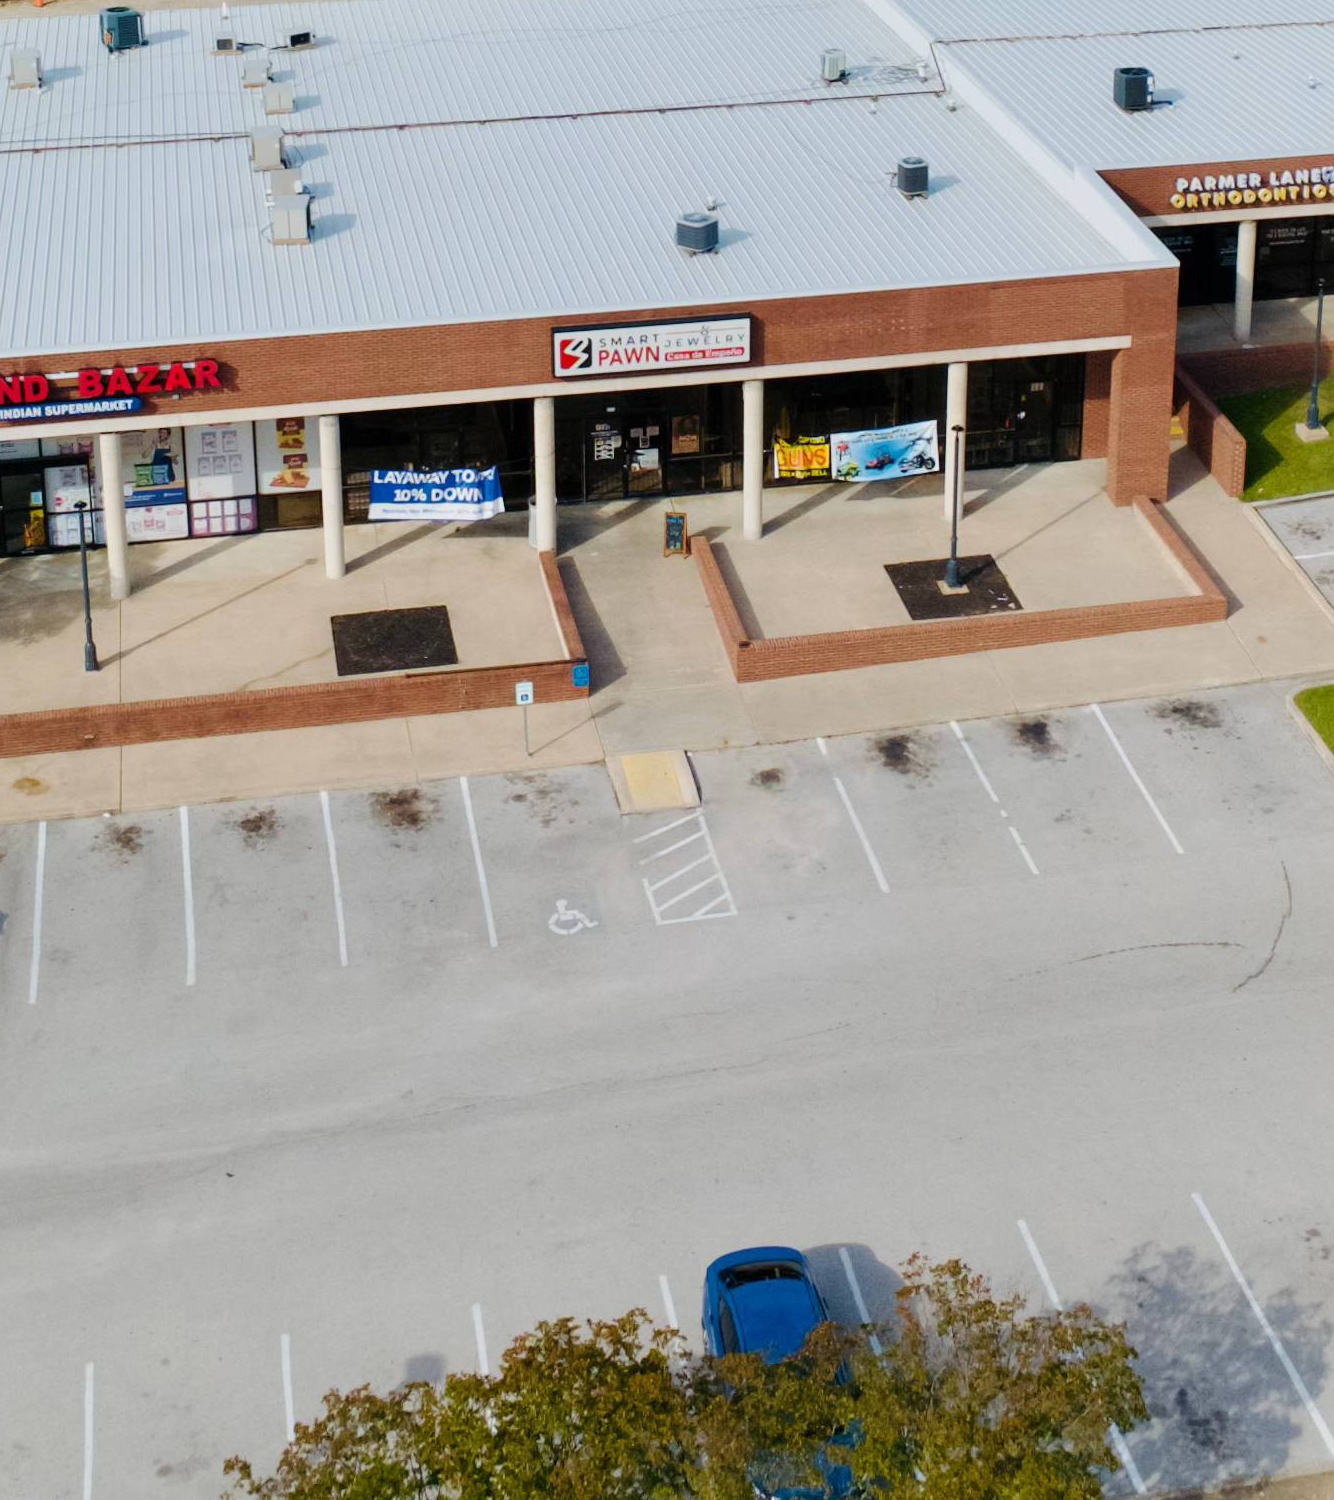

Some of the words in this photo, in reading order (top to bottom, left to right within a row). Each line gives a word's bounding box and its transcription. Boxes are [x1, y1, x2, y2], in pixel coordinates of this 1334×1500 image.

[1176, 172, 1262, 193] PARMER
[1269, 167, 1321, 187] LANE
[599, 334, 660, 348] SMART
[664, 334, 745, 349] JEWELRY
[599, 346, 660, 367] PAWN
[667, 351, 690, 361] Casa
[692, 350, 703, 360] de
[80, 359, 222, 397] BAZAR
[0, 405, 42, 420] INDIAN
[44, 399, 134, 417] SUPERMARKET
[373, 470, 449, 484] LAYAWAY
[394, 488, 427, 502] 10%
[431, 487, 483, 502] DOWN
